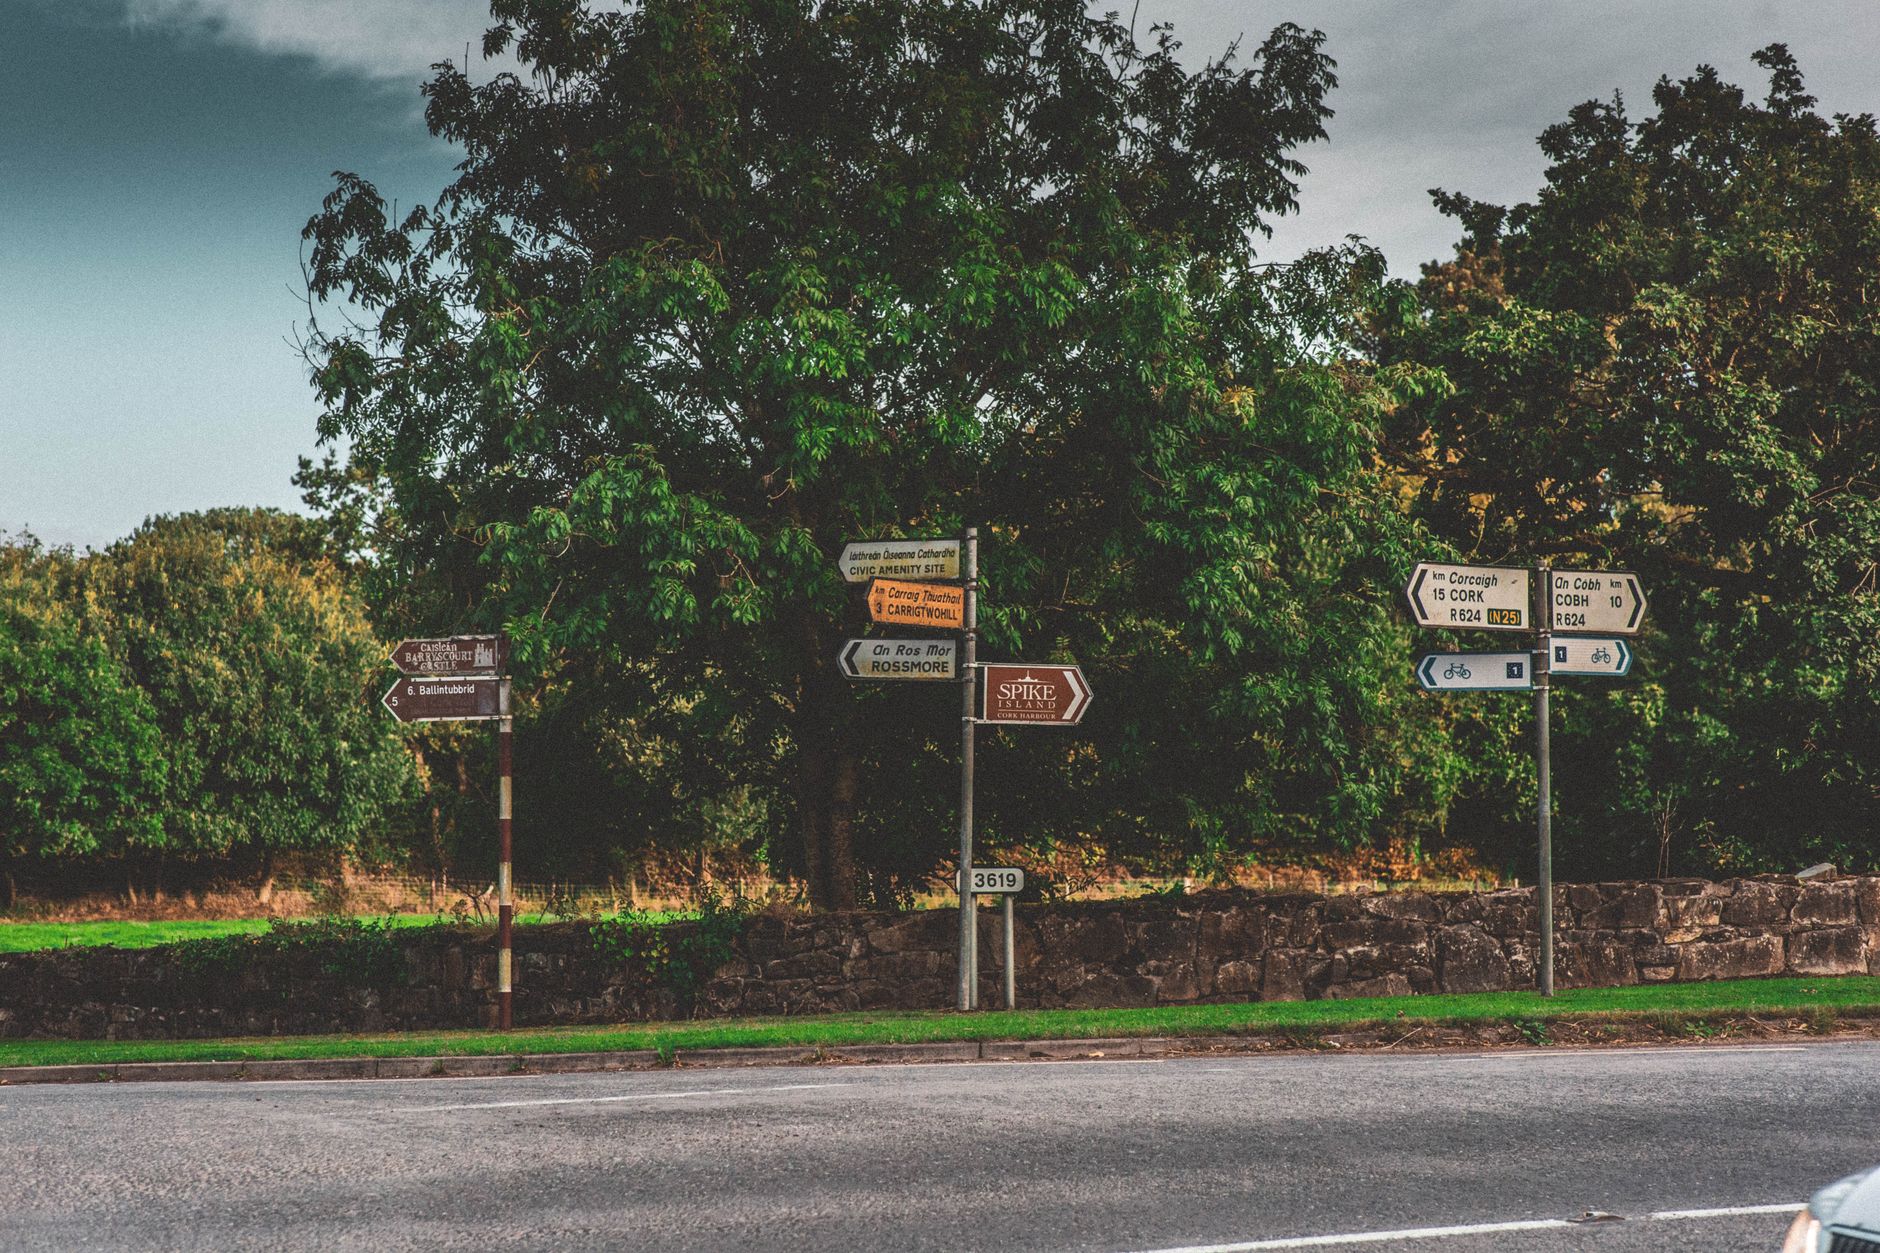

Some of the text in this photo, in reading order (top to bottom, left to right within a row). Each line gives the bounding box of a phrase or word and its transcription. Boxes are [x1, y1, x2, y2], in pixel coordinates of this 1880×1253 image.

[850, 564, 945, 576] CIVIC AMENITY SITE
[1433, 571, 1498, 588] km Corcaigh
[1555, 577, 1568, 589] An
[1610, 579, 1622, 588] km
[875, 586, 960, 605] km Carraig Thuathail
[1432, 588, 1484, 602] 15 CORK
[1556, 594, 1622, 608] COBH 10
[876, 602, 958, 620] 3 CARRIGTWOHILL
[873, 644, 952, 656] An Ros Mór
[405, 651, 473, 662] BARRYSCOURT
[420, 662, 458, 672] CASTLE
[872, 661, 949, 673] ROSSMORE
[420, 684, 474, 694] Ballintubbrid
[997, 684, 1056, 700] SPIKE
[998, 700, 1056, 709] ISLAND
[974, 873, 1016, 887] 3619
